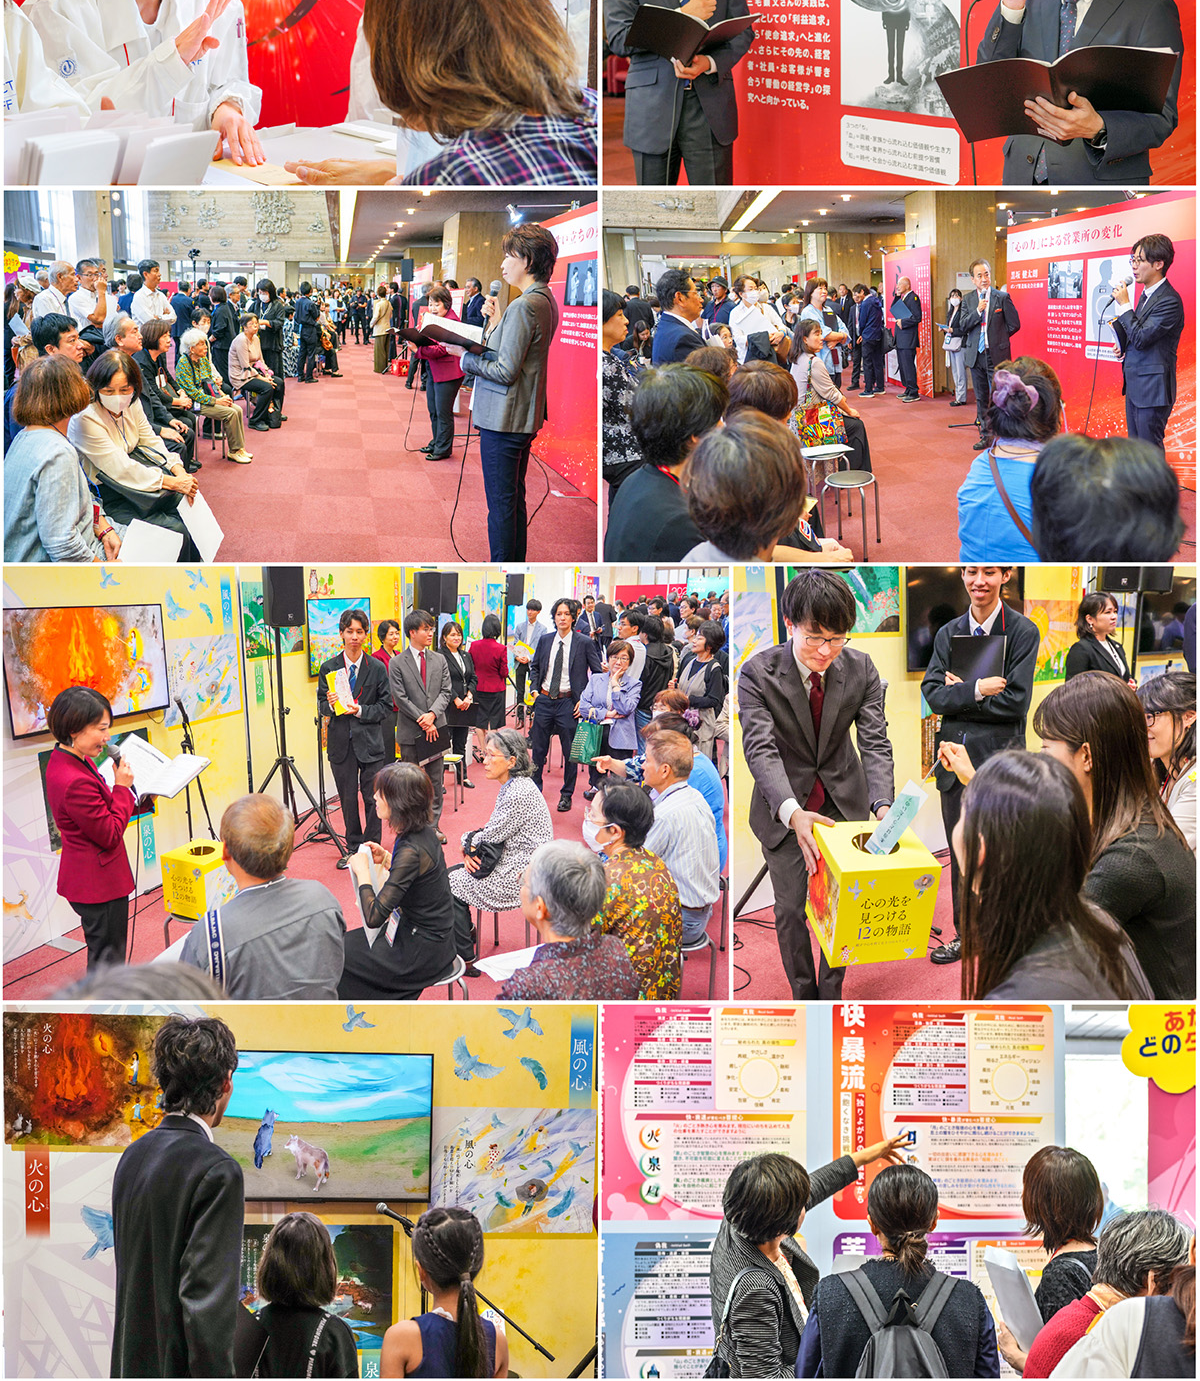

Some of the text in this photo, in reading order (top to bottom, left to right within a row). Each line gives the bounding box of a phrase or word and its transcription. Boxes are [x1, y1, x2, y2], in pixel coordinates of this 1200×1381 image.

[222, 590, 231, 623] 風の心
[143, 824, 154, 859] 泉の心
[171, 875, 194, 886] 心の光を
[172, 882, 194, 894] 見つける
[172, 891, 197, 904] 12の物語
[861, 896, 912, 909] 心の光を
[860, 911, 907, 925] 見つける
[857, 923, 912, 940] 12の物語
[42, 1023, 53, 1055] 火の心
[571, 1038, 589, 1091] 風の心
[842, 1093, 851, 1156] 「飽くなき挑戦
[464, 1139, 475, 1169] 風の心
[27, 1159, 45, 1213] 火の心
[364, 1361, 380, 1378] 泉
